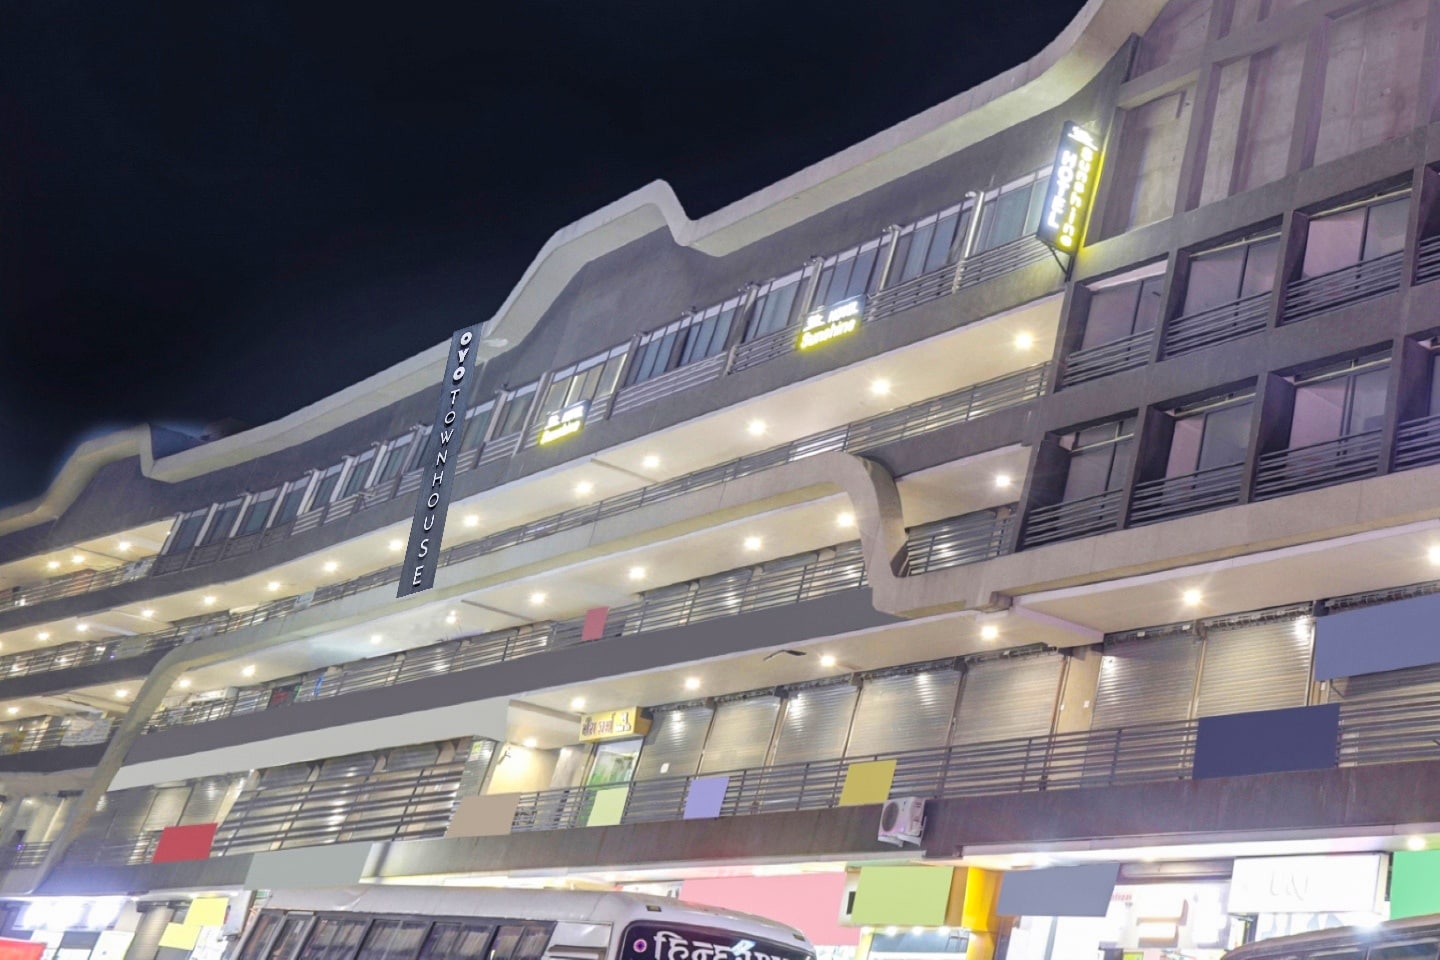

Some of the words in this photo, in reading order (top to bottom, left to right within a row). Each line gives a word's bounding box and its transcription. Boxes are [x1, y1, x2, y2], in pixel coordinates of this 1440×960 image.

[1047, 150, 1078, 229] HOTEL
[453, 331, 472, 381] OYO
[412, 388, 460, 586] TOWNHOUSE
